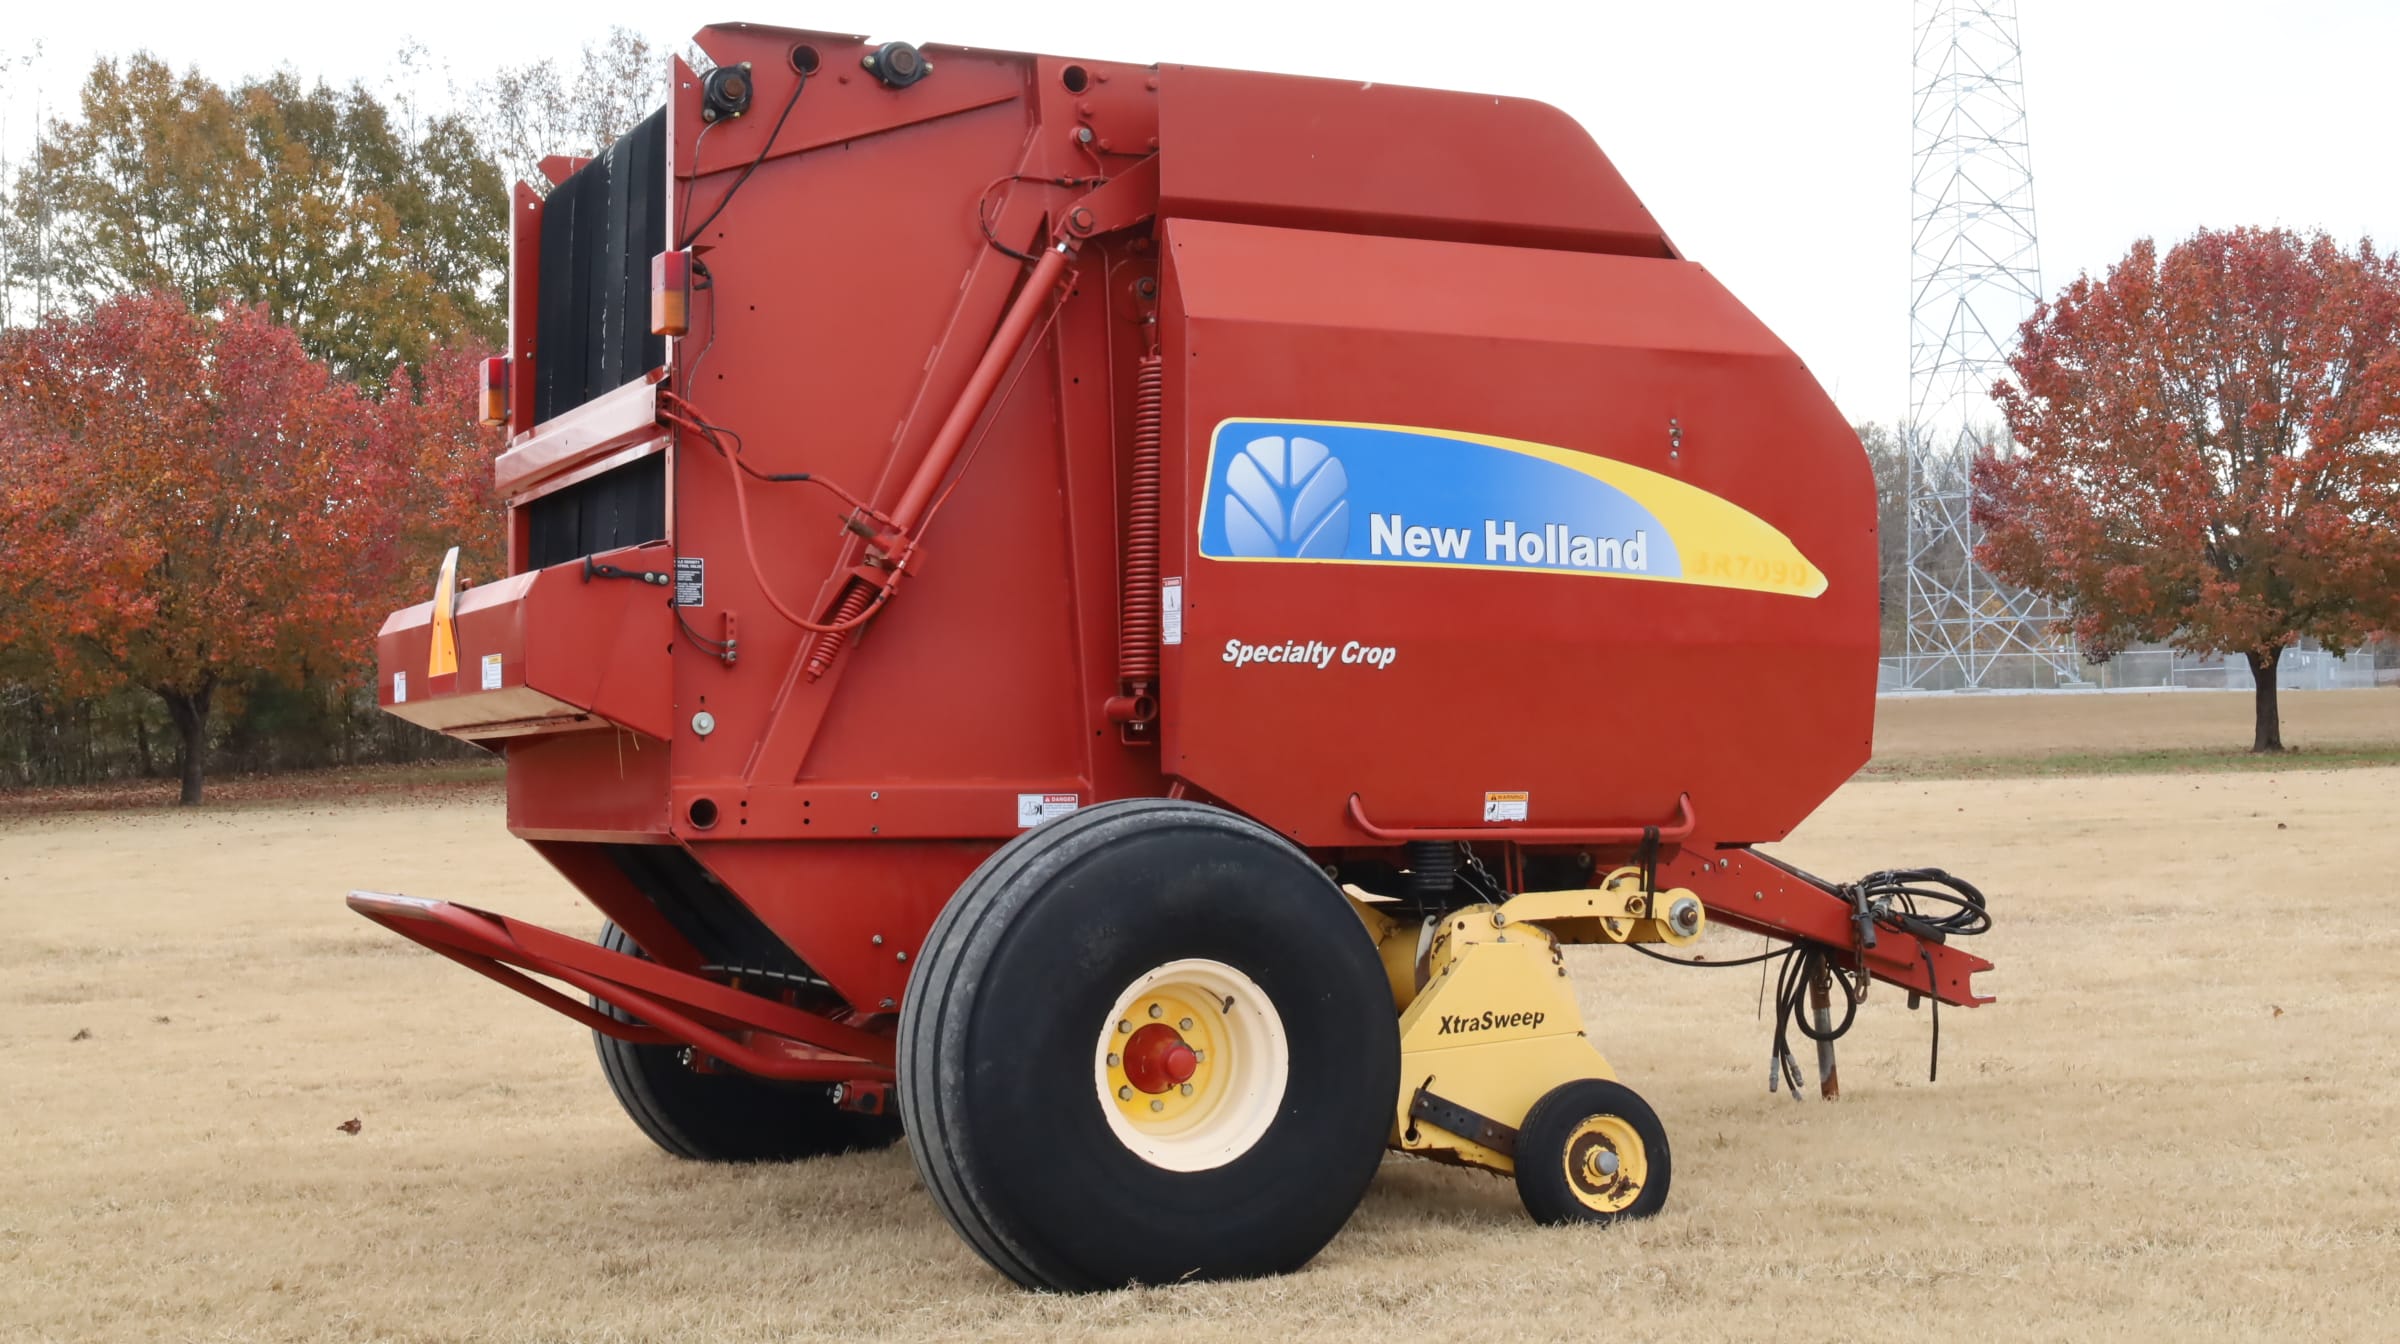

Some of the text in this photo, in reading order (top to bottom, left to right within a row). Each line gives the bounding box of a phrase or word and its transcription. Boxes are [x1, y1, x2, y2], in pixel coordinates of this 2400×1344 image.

[1369, 512, 1647, 571] New Holland
[1222, 639, 1396, 670] Specialty Crop
[1438, 1010, 1545, 1036] XtraSweep
